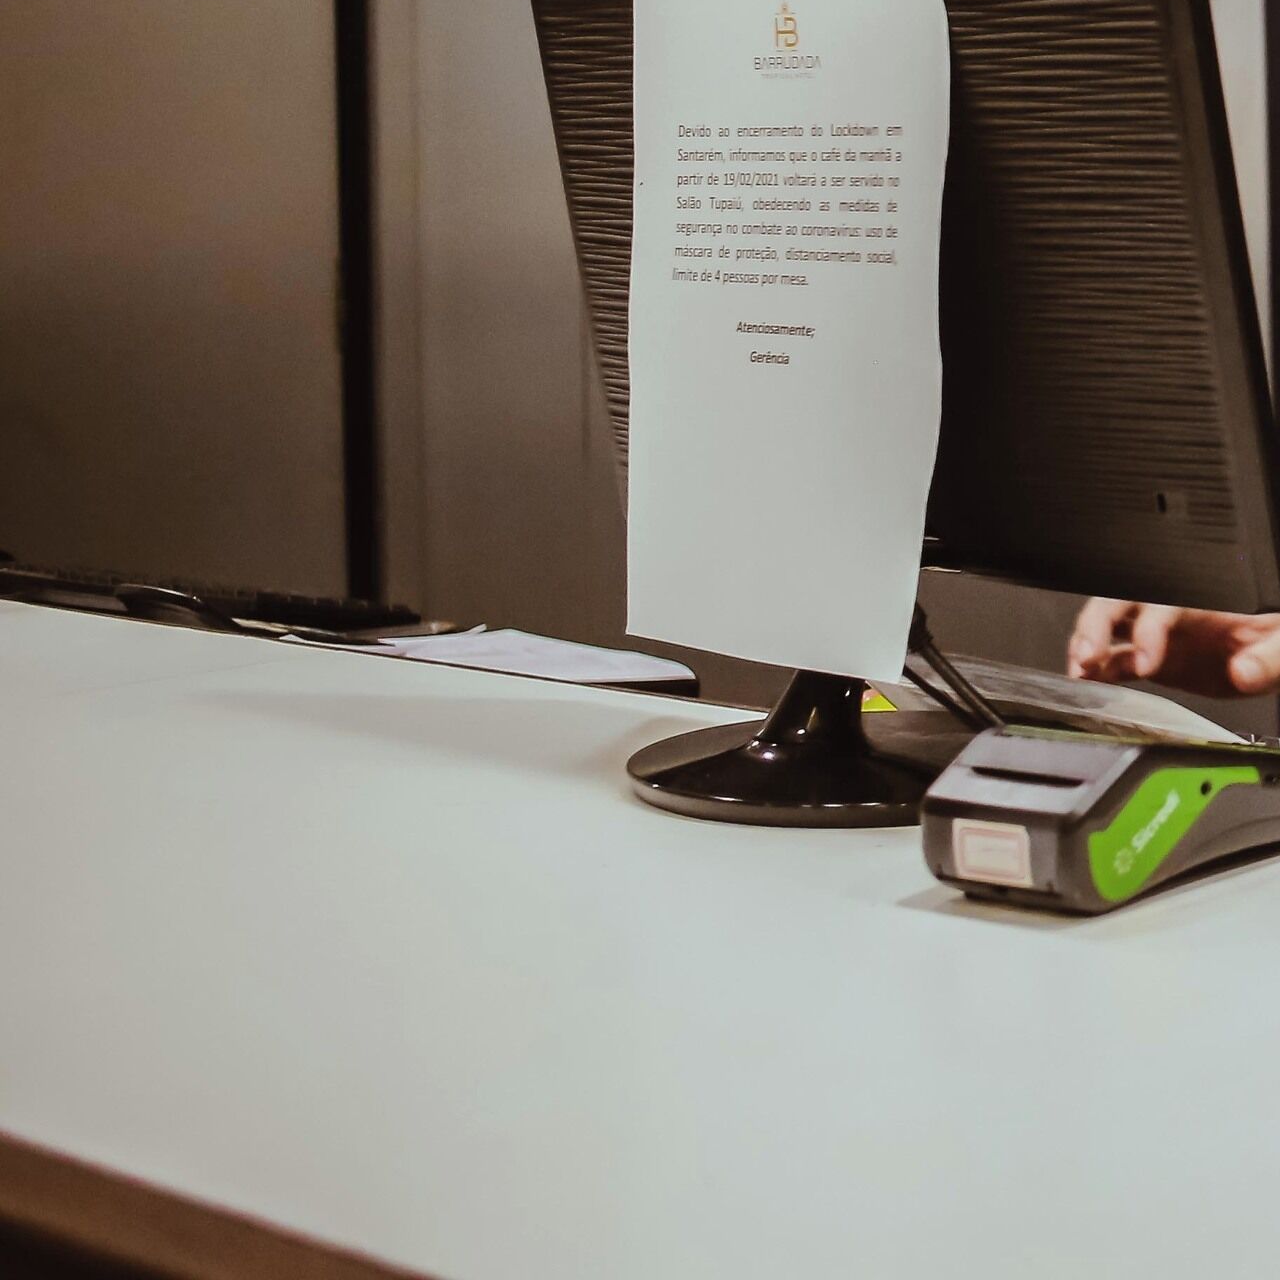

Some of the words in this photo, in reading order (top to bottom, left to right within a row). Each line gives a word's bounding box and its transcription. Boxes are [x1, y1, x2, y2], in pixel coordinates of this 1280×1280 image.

[678, 125, 711, 137] Devido
[719, 127, 729, 137] ao
[738, 126, 803, 137] encerramento
[811, 125, 823, 136] do
[831, 124, 879, 136] Lockdown
[887, 126, 903, 136] em
[677, 148, 725, 162] Santarém,
[730, 148, 785, 161] informamos
[789, 152, 807, 163] que
[812, 152, 817, 161] o
[821, 148, 840, 161] café
[845, 149, 856, 161] da
[860, 148, 891, 161] manhã
[896, 152, 901, 161] a
[677, 173, 703, 187] partir
[708, 173, 719, 185] de
[724, 173, 778, 187] 19/02/2021
[784, 173, 816, 186] voltará
[821, 177, 826, 186] a
[831, 177, 845, 187] ser
[850, 175, 883, 187] servido
[888, 177, 899, 187] no
[677, 197, 701, 210] Salão
[753, 199, 811, 211] obedecendo
[819, 201, 830, 211] as
[839, 199, 879, 212] medidas
[887, 201, 897, 212] de
[676, 223, 722, 236] segurança
[727, 224, 738, 233] no
[742, 223, 782, 235] combate
[786, 226, 797, 235] ao
[866, 227, 882, 237] uso
[886, 225, 898, 238] de
[675, 246, 712, 258] máscara
[719, 246, 730, 258] de
[736, 247, 779, 262] proteção,
[785, 248, 861, 262] distanciamento
[672, 269, 698, 281] limite
[701, 269, 712, 281] de
[715, 269, 721, 281] 4
[723, 272, 759, 286] pessoas
[761, 273, 778, 286] por
[781, 275, 808, 286] mesa.
[750, 351, 789, 365] Gerência
